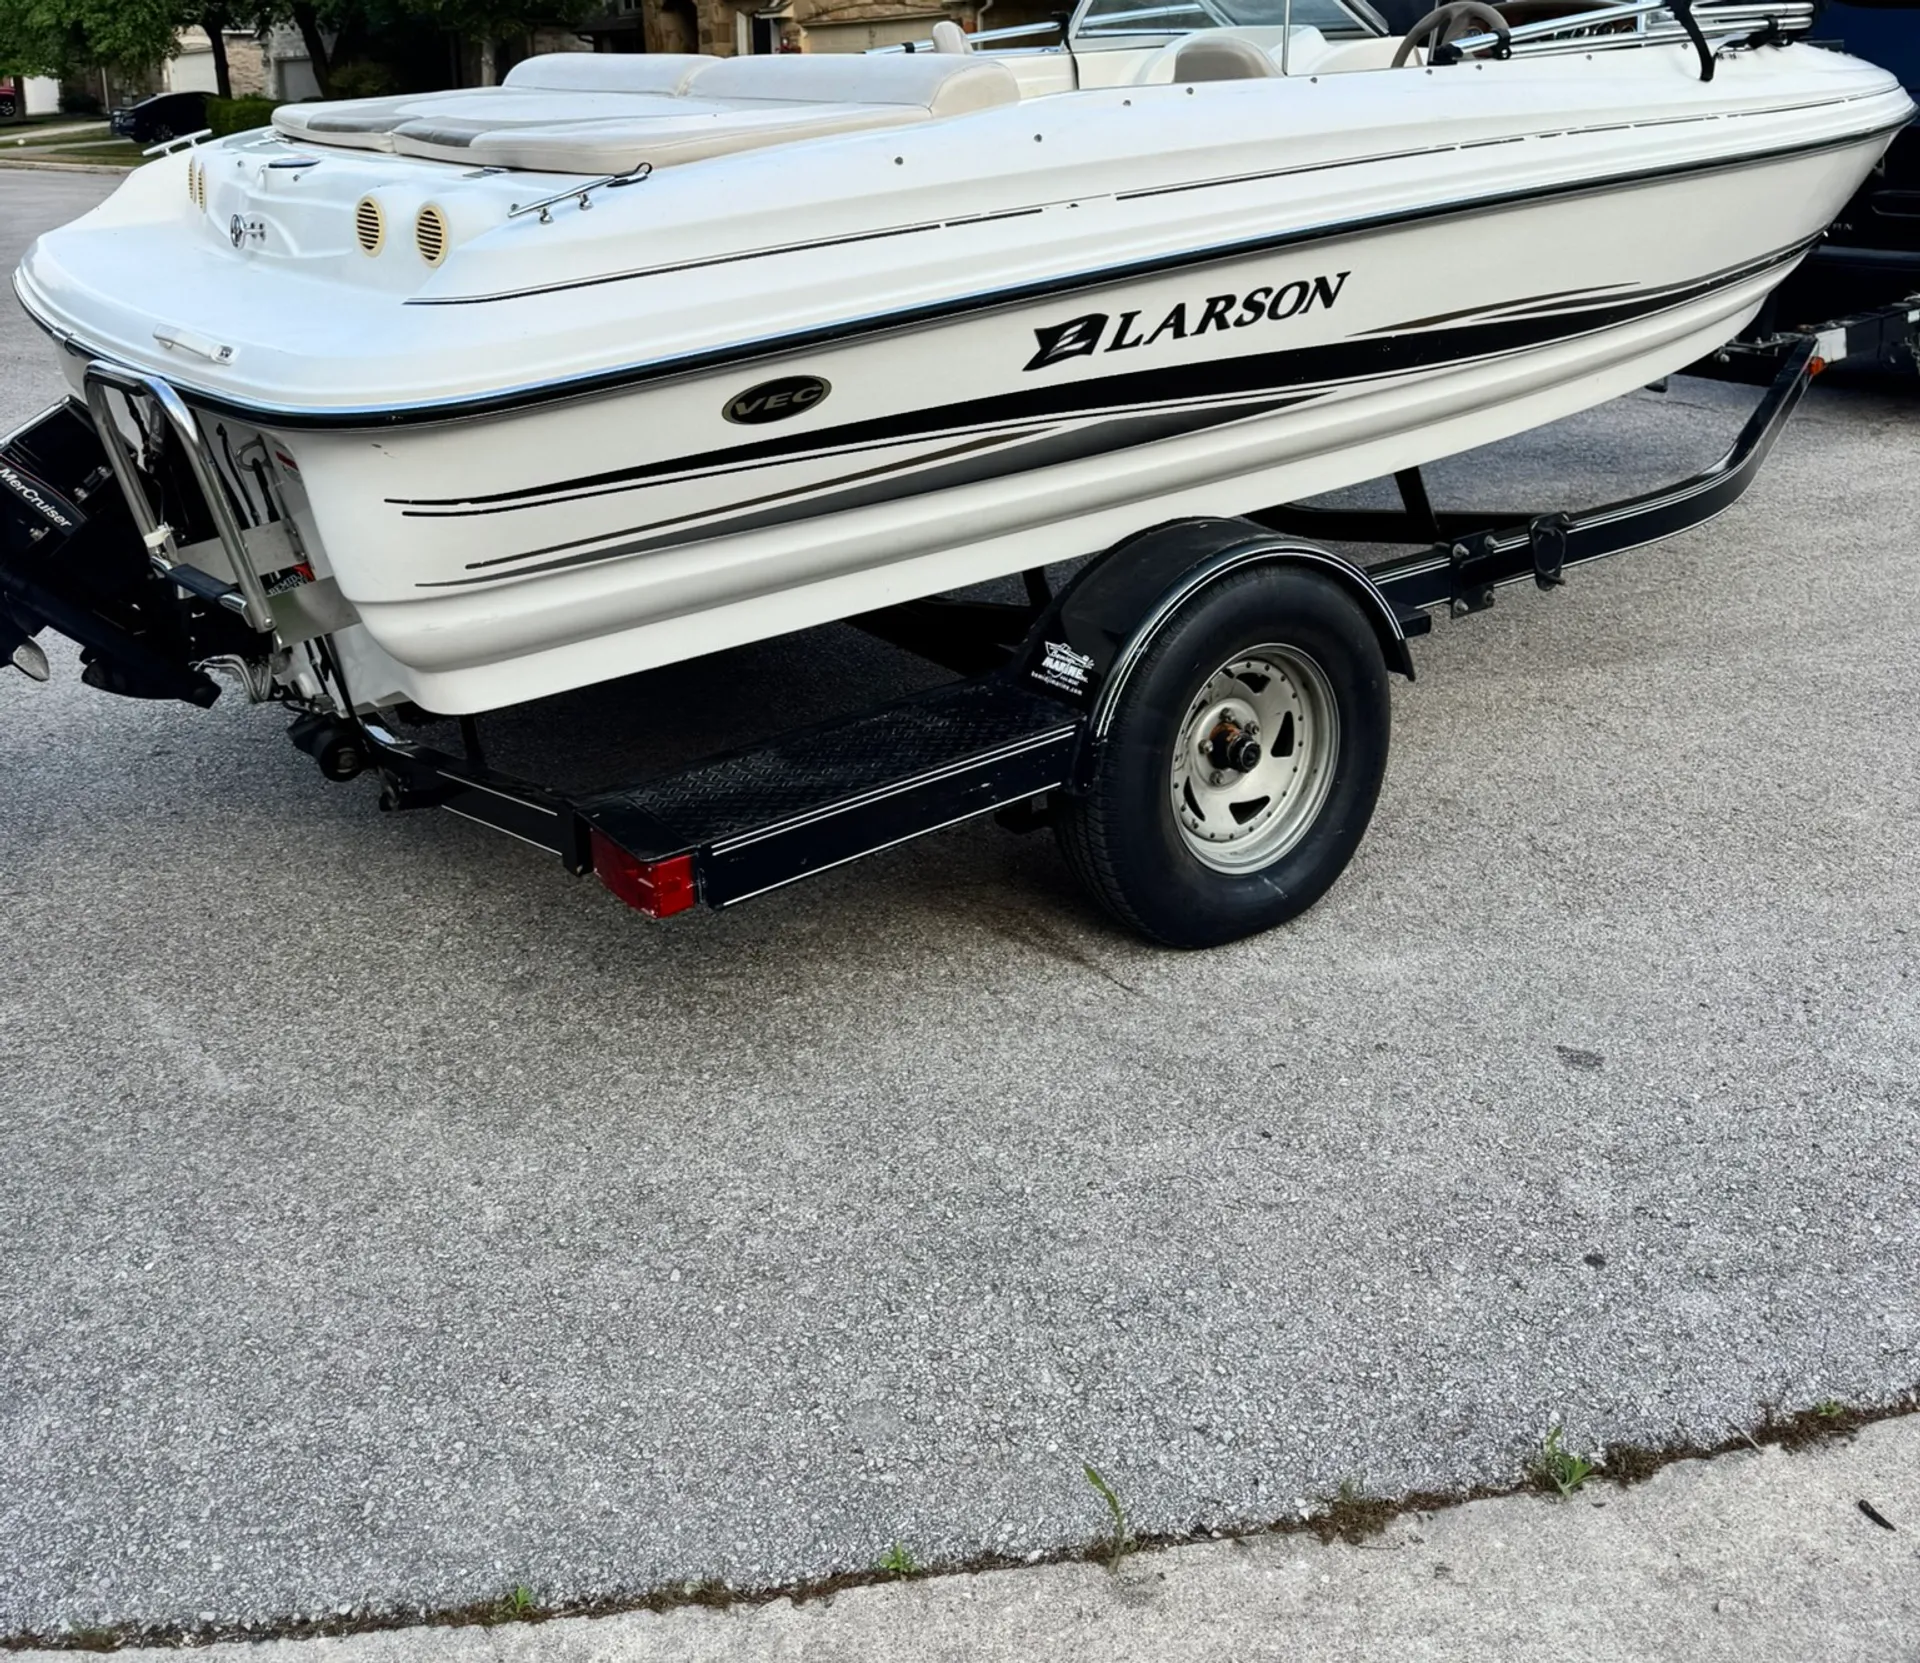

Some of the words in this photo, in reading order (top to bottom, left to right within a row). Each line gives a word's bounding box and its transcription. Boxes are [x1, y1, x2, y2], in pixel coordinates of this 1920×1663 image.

[1103, 271, 1352, 353] LARSON
[735, 385, 823, 416] VEC
[0, 468, 72, 526] MerCruiser
